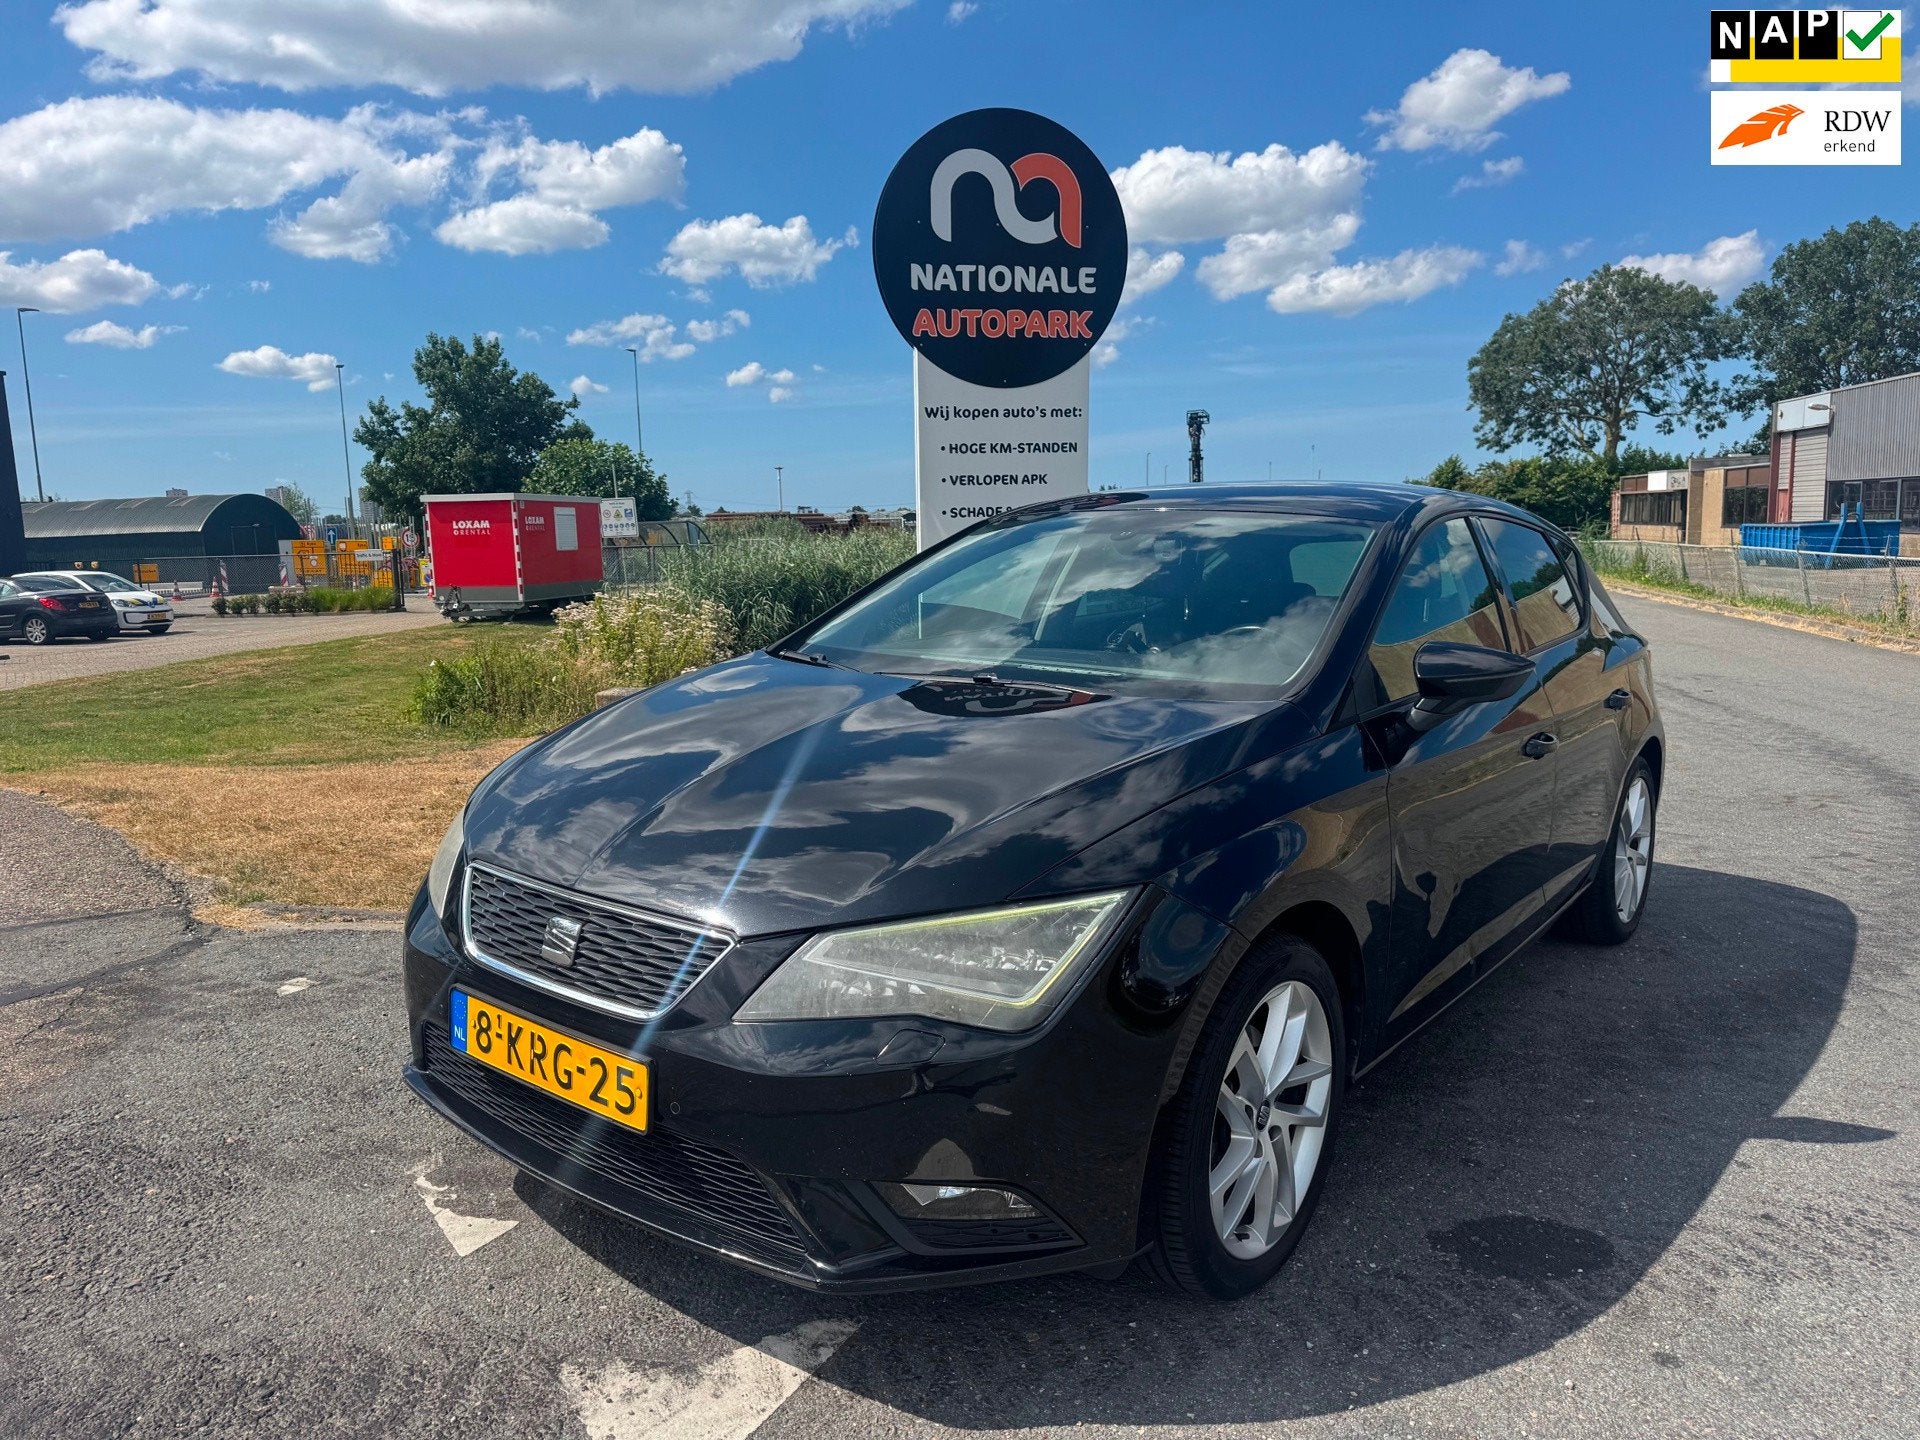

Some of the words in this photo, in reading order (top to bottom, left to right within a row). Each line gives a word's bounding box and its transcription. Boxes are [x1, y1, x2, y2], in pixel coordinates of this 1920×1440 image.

[910, 262, 1097, 294] NATIONALE
[912, 308, 1094, 339] AUTOPARK
[924, 406, 950, 421] Wij
[953, 406, 999, 420] kopen
[1003, 405, 1047, 419] auto's
[1050, 406, 1083, 418] met:
[949, 442, 987, 454] HOGE
[990, 442, 1078, 454] KM-STANDEN
[949, 474, 1019, 486] VERLOPEN
[1021, 474, 1048, 485] APK
[950, 506, 1003, 518] SCHADE
[452, 520, 491, 529] LOXAM
[524, 516, 545, 525] LOXAM
[454, 1025, 466, 1042] NL
